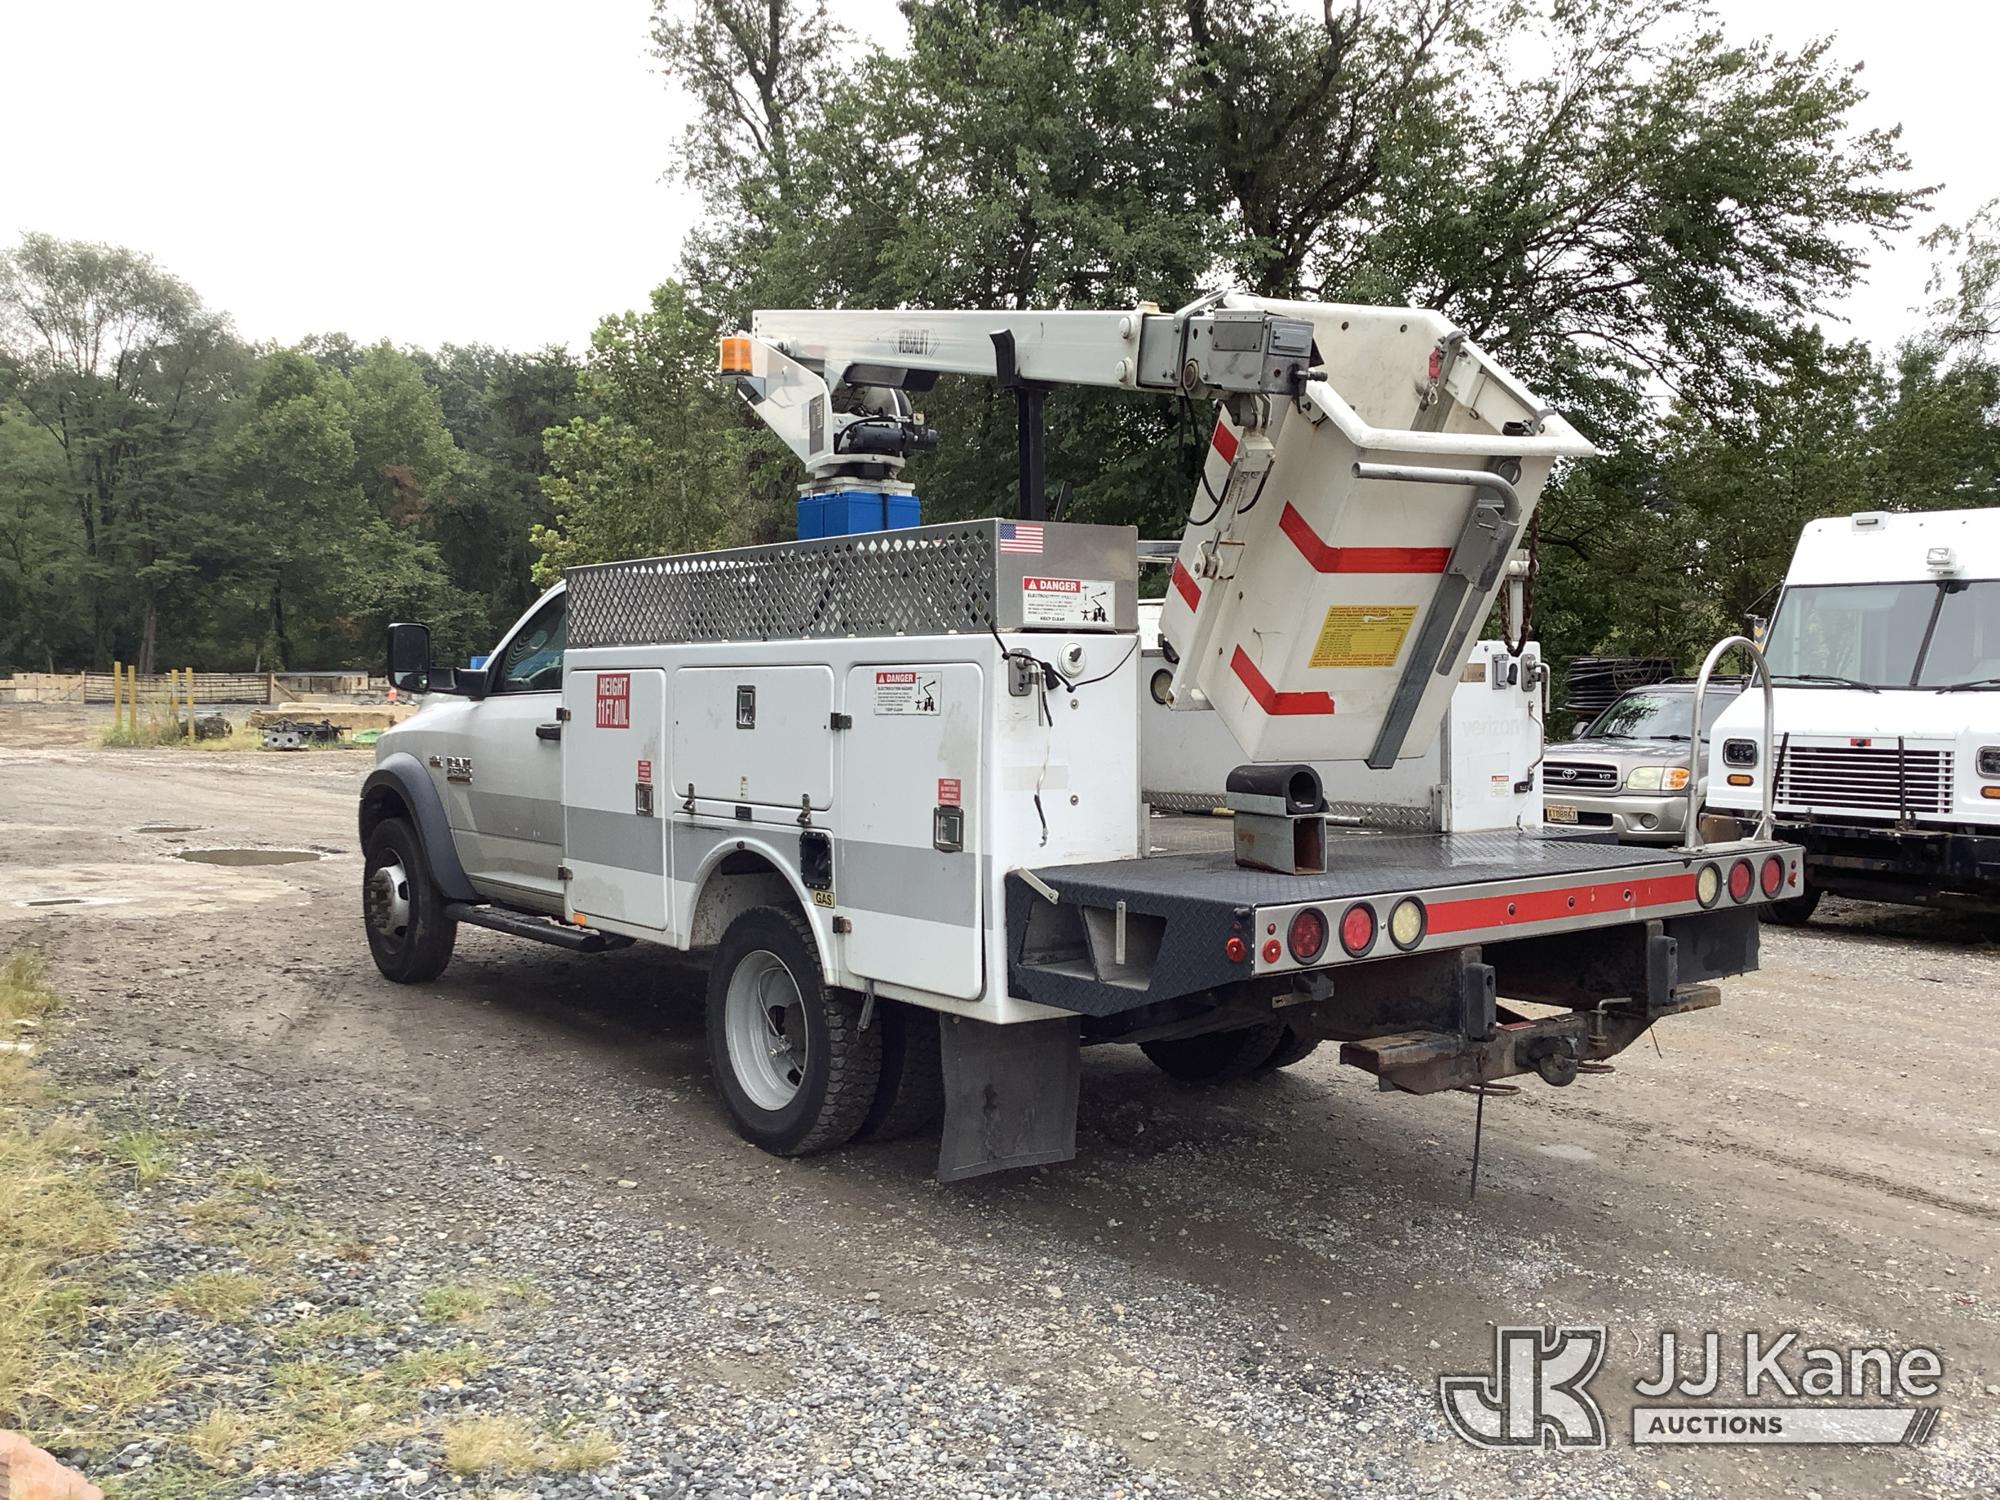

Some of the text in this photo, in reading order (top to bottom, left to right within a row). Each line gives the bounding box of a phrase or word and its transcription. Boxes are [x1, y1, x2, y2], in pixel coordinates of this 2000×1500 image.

[1040, 580, 1077, 591] DANGER
[886, 673, 914, 682] DANGER
[599, 677, 628, 696] HEIGHT
[815, 892, 832, 905] GAS
